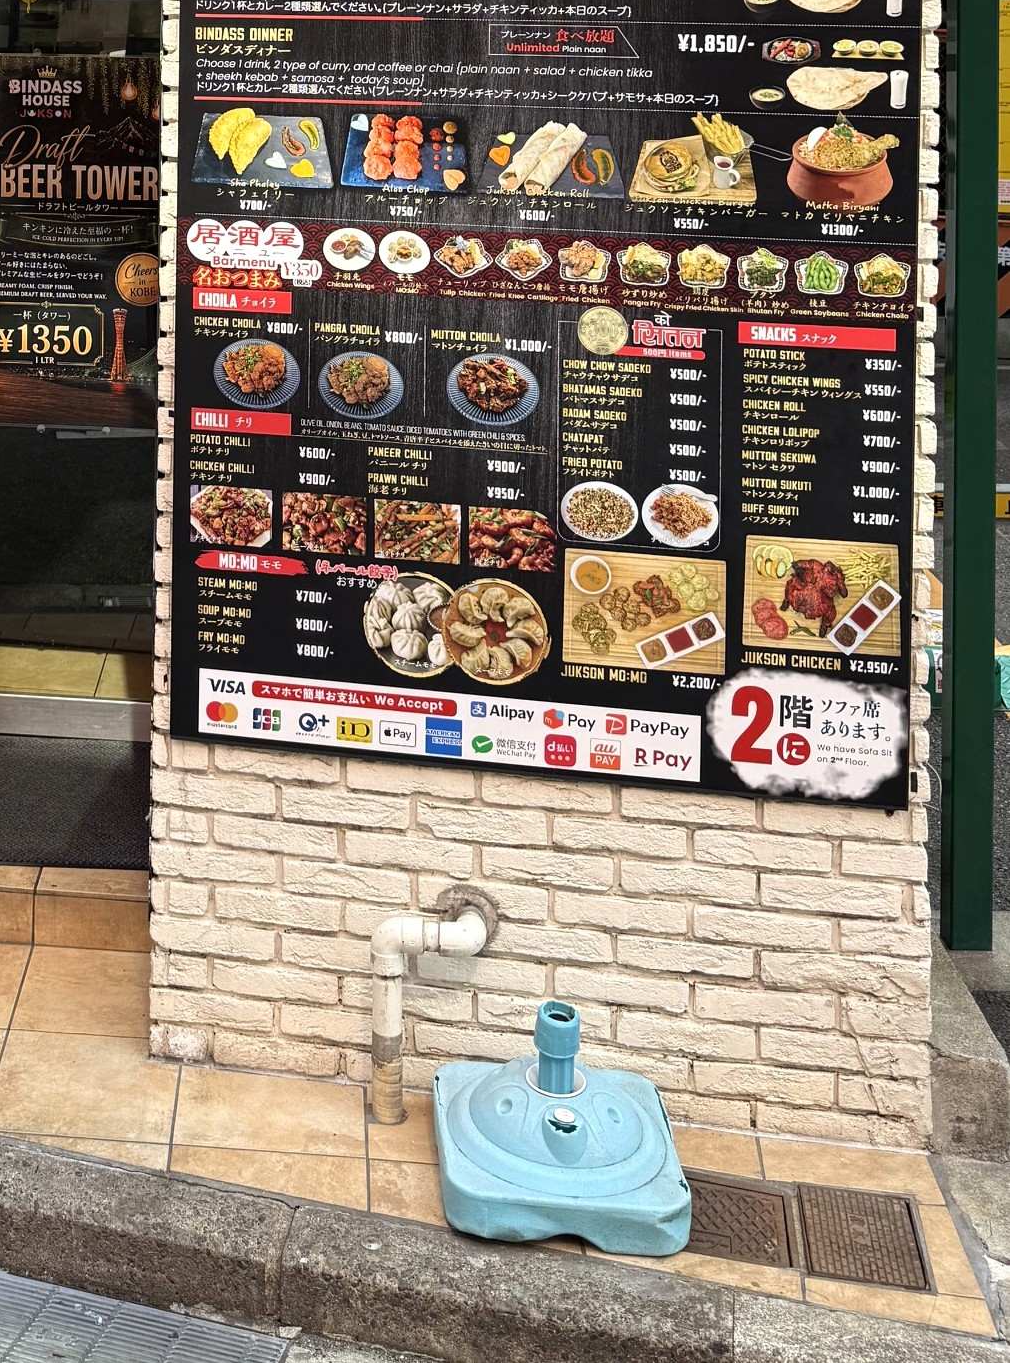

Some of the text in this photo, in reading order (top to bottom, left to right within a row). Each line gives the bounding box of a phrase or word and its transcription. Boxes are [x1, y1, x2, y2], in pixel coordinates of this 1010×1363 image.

[195, 28, 293, 41] BINDASS DINNER
[196, 43, 291, 55] ビンダスディナー
[678, 35, 754, 53] ¥1,850/-
[9, 79, 82, 94] BINDASS
[22, 95, 70, 106] HOUSE
[0, 125, 96, 170] Draft
[0, 164, 158, 200] BEER TOWER
[38, 202, 118, 211] ドラフトビールタワー
[806, 201, 879, 213] Matka Biryani
[192, 225, 301, 246] 居酒屋
[212, 256, 275, 268] Bar menu
[125, 263, 158, 278] Cheers
[195, 268, 281, 287] 名おつまみ
[131, 288, 157, 296] KOBE
[199, 293, 277, 308] CHOILA チョイラ
[654, 310, 672, 326] को
[315, 323, 380, 335] PANGRA CHOILA
[751, 326, 838, 344] SNACKS スナック
[744, 349, 805, 361] POTATO STICK
[563, 360, 651, 373] CHOW CHOW SADEKO
[865, 358, 902, 371] ¥350/-
[744, 374, 840, 388] SPICY CHICKEN WINGS
[865, 384, 901, 396] ¥550/-
[195, 412, 252, 427] CHILLI チリ
[191, 435, 250, 447] POTATO CHILLI
[562, 457, 622, 471] FRIED POTATO
[742, 450, 816, 464] MUTTON SEKUWA
[219, 554, 281, 571] MO:MO モモ
[741, 651, 841, 671] JUKSON CHICKEN
[207, 678, 246, 695] VISA
[261, 685, 444, 711] スマホで簡単お支払い We Accept
[490, 705, 534, 722] Alipay
[821, 699, 880, 719] ソファ席
[340, 721, 370, 738] iD
[631, 722, 689, 738] PayPay
[731, 686, 813, 764] 2 階
[821, 721, 891, 741] あります。
[497, 739, 536, 751] 微信支付
